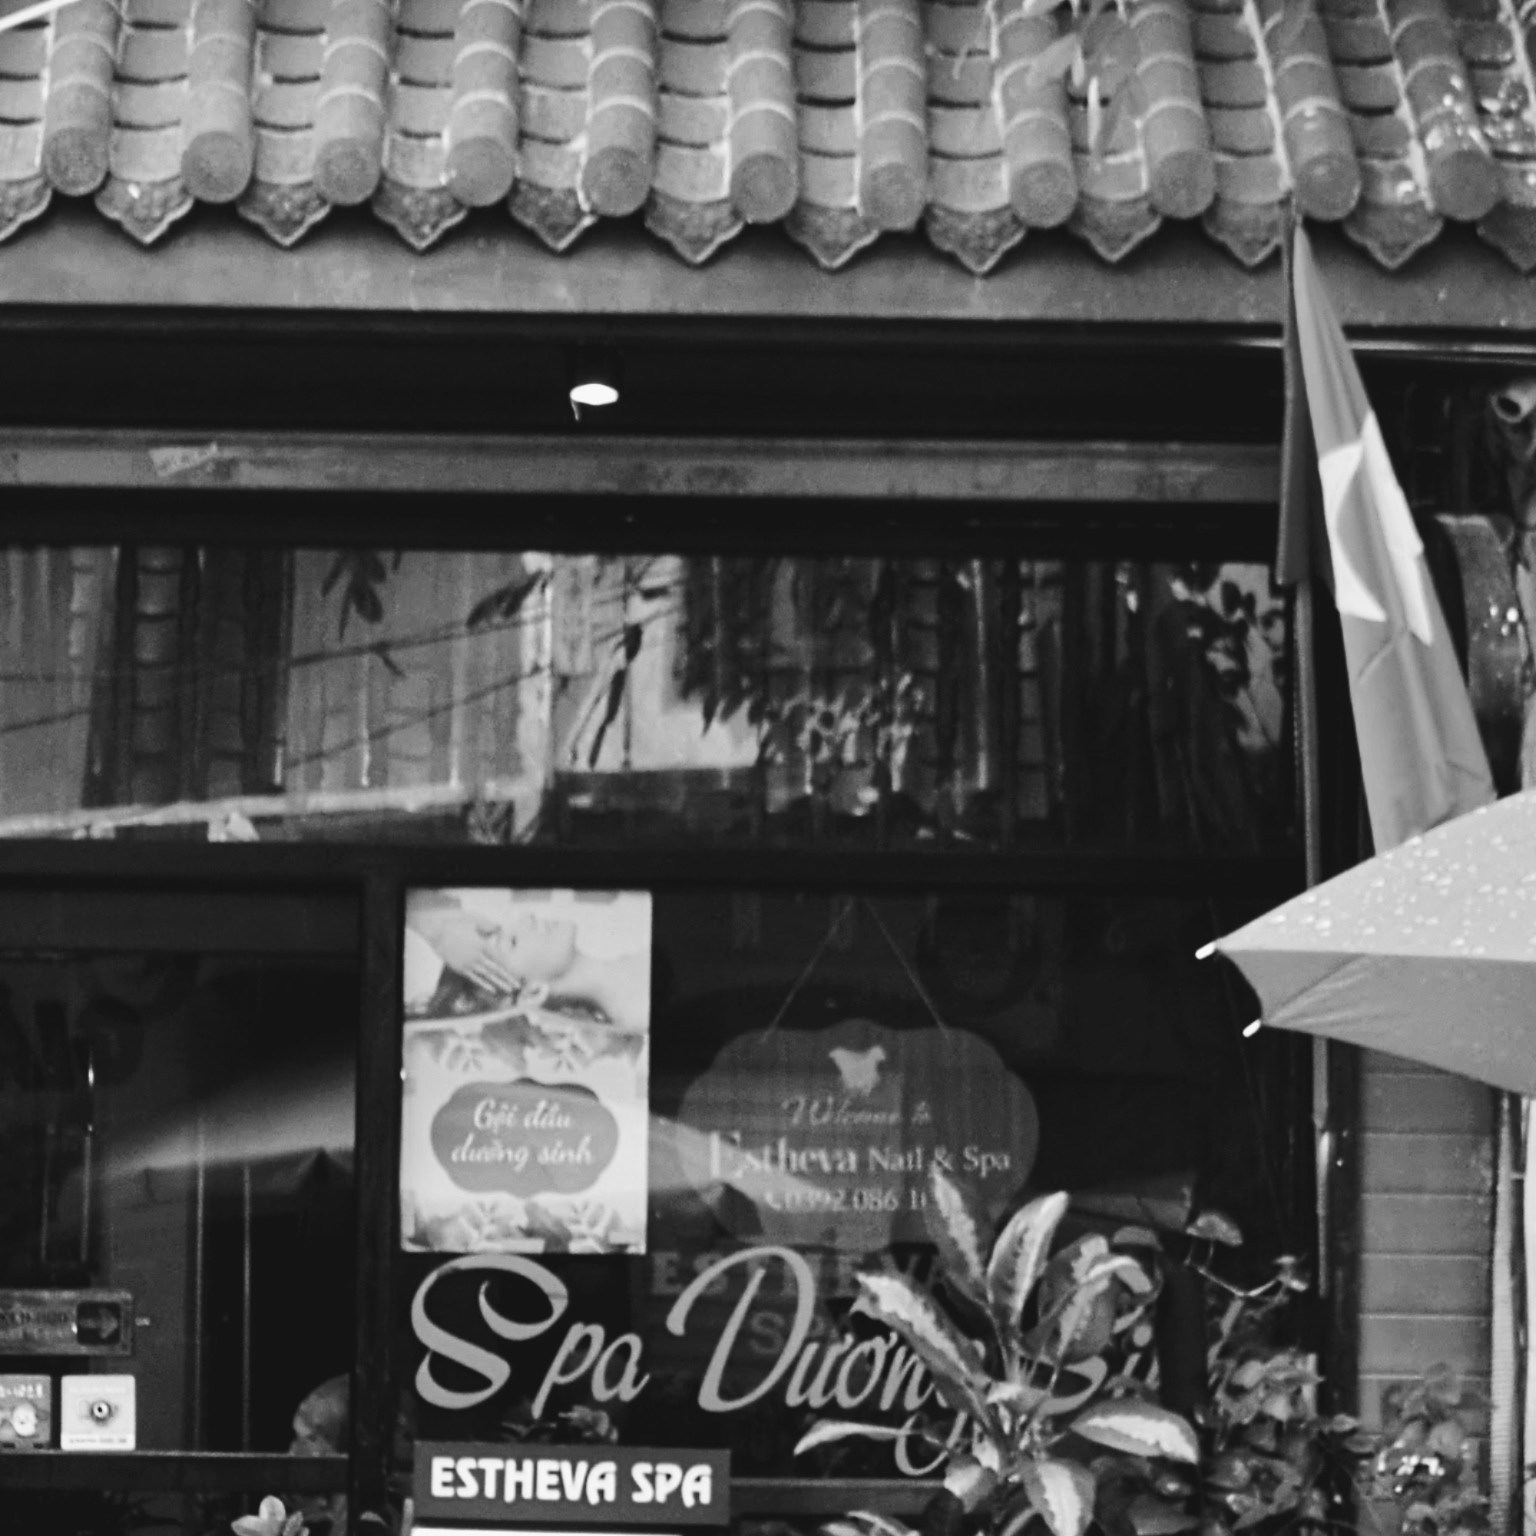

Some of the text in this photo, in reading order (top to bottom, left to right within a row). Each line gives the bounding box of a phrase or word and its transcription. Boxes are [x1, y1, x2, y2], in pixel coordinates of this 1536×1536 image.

[472, 1096, 520, 1133] Gội
[537, 1133, 593, 1166] sinh
[709, 1130, 857, 1179] Estheva
[868, 1145, 924, 1173] Nail
[962, 1145, 1012, 1179] Spa
[410, 1252, 652, 1421] Spa
[430, 1456, 714, 1509] ESTHEVA SPA
